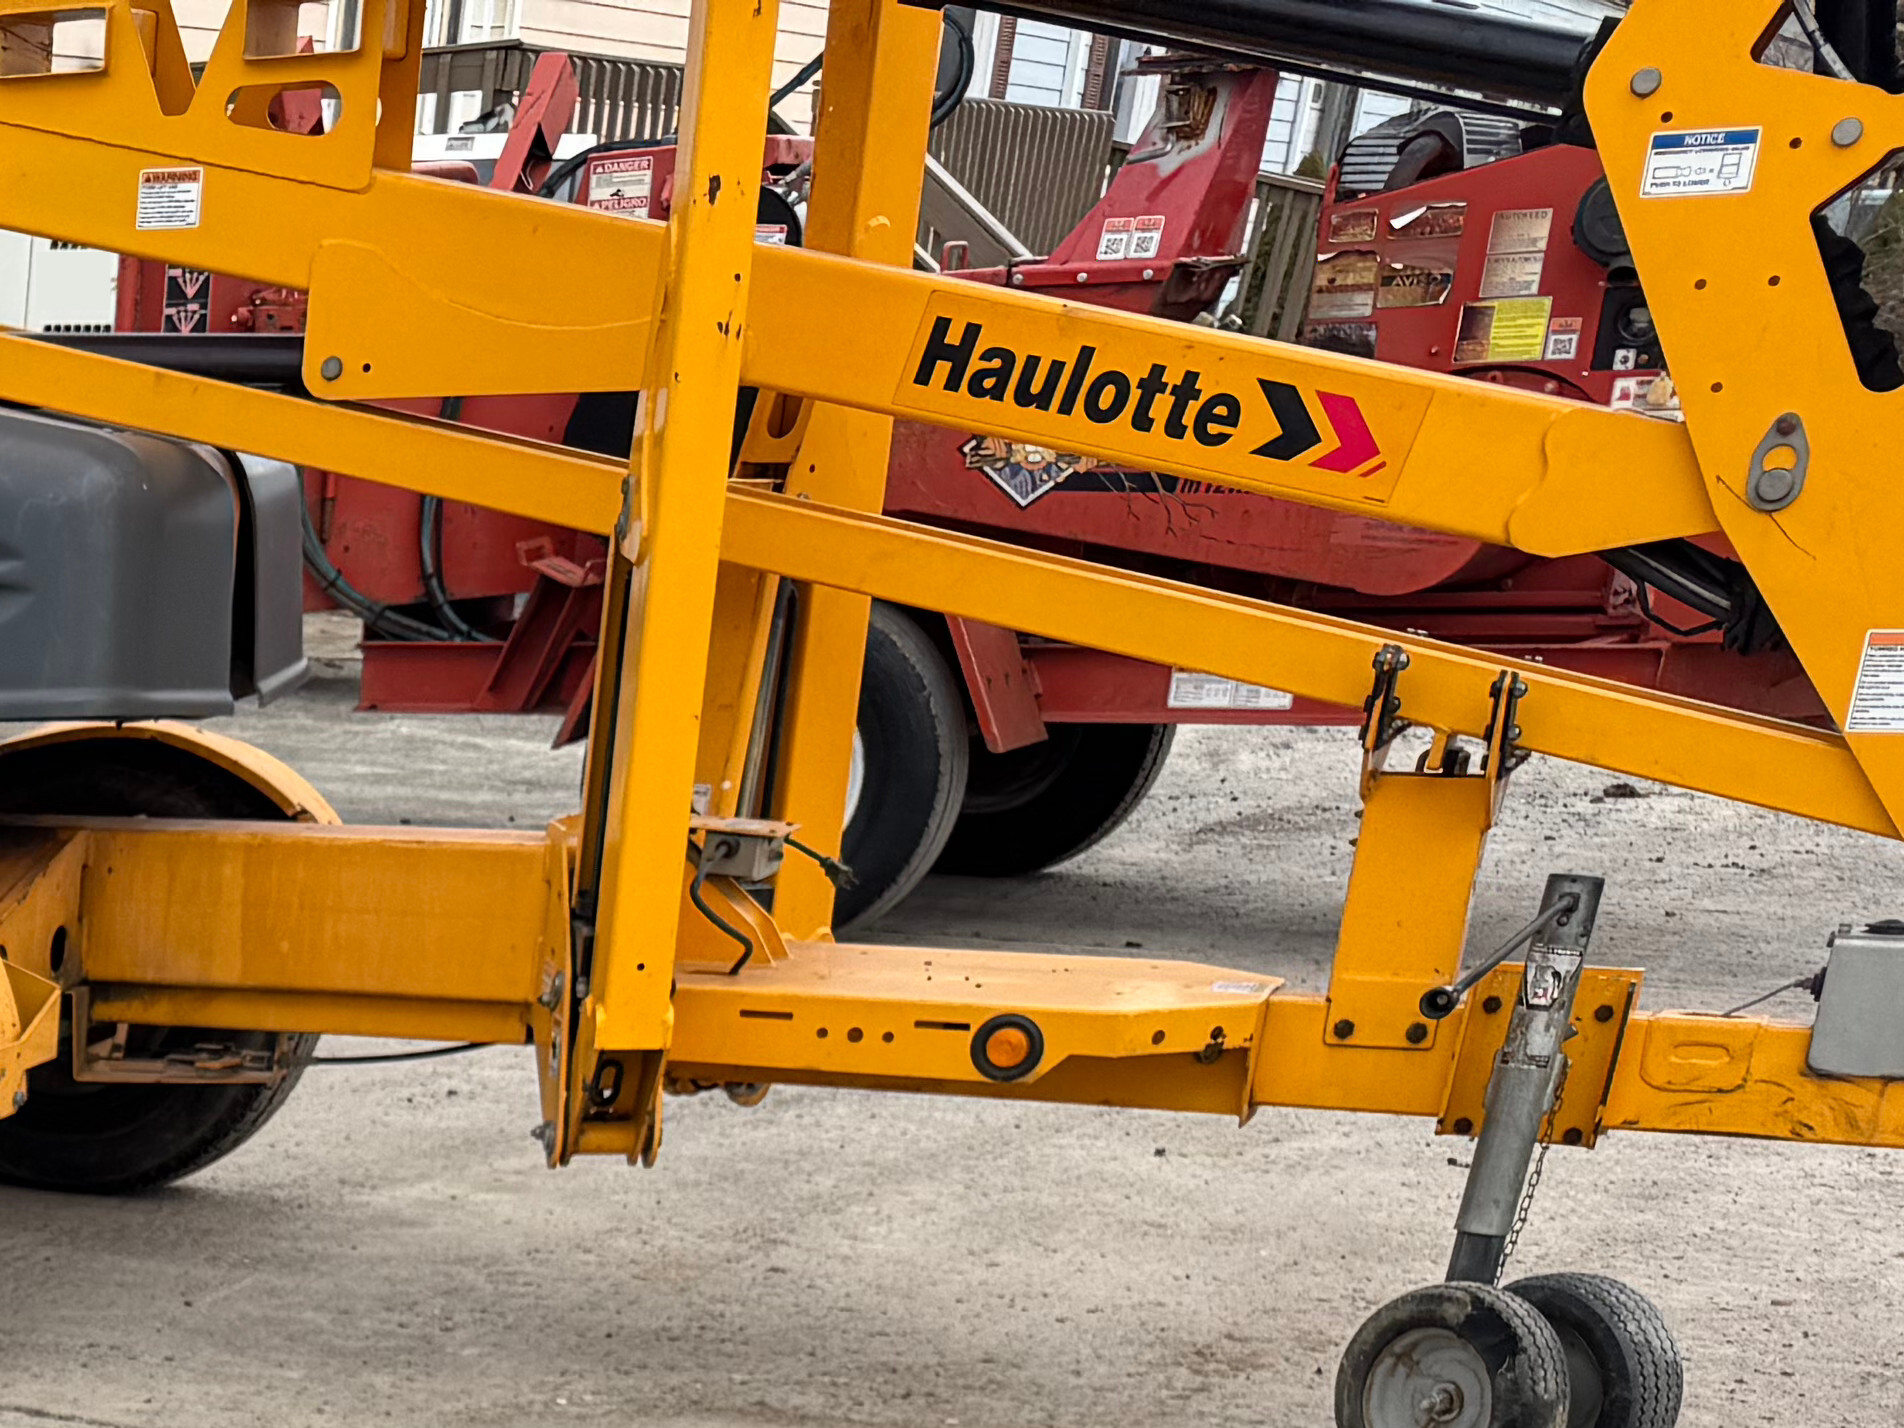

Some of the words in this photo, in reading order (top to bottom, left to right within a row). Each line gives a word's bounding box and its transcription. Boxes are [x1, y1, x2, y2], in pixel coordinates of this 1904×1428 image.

[1683, 132, 1726, 146] NOTICE
[604, 159, 650, 174] DANGER
[601, 196, 648, 212] PELIGRO
[913, 315, 1242, 447] Haulotte
